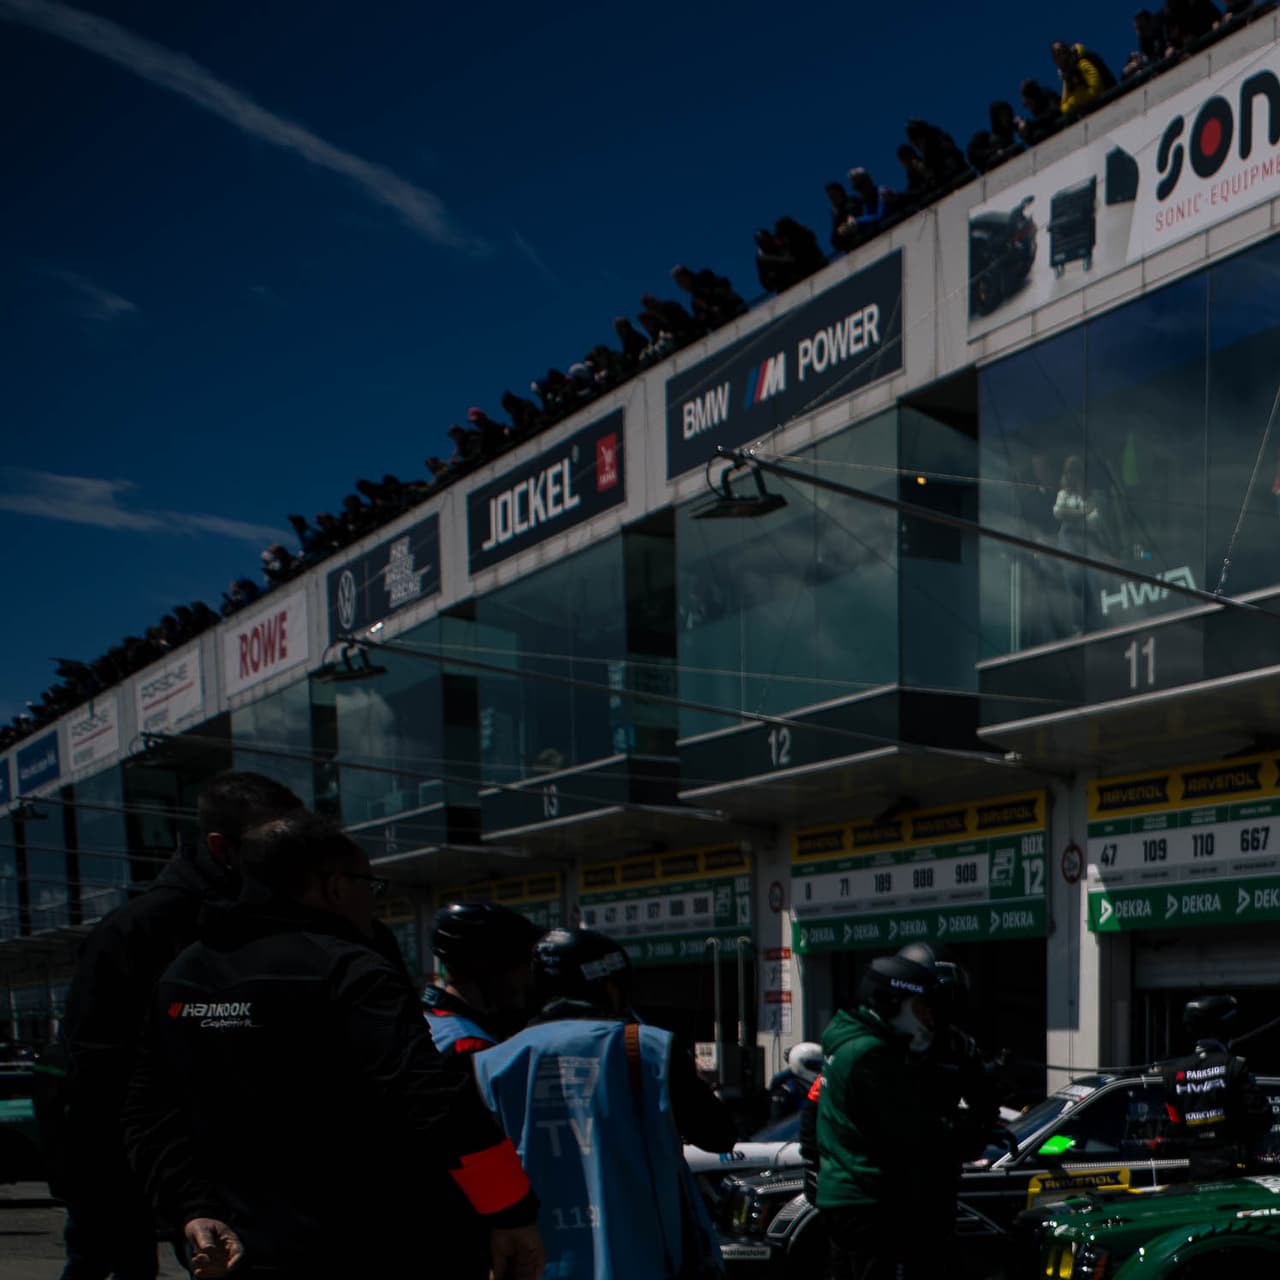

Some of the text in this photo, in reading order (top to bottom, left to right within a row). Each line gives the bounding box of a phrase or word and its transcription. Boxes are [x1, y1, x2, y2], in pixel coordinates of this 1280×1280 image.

[682, 381, 731, 440] BMW
[798, 303, 880, 381] POWER
[481, 457, 581, 551] JOCKEL
[1101, 566, 1197, 615] HWA
[239, 611, 287, 679] ROWE
[1125, 636, 1155, 688] 11
[768, 727, 792, 767] 12
[1187, 769, 1253, 795] RAVENOL
[1021, 833, 1044, 856] BOX
[1143, 838, 1168, 862] 109
[1192, 832, 1215, 857] 110
[1240, 826, 1271, 852] 667
[1101, 844, 1118, 866] 47
[1022, 858, 1045, 897] 12
[1115, 898, 1153, 919] DEKRA
[1182, 892, 1222, 915] DEKRA
[949, 914, 979, 934] DEKRA
[1002, 911, 1035, 930] DEKRA
[1186, 1065, 1227, 1079] PARKSIDE
[1044, 1173, 1118, 1192] RAVENOL
